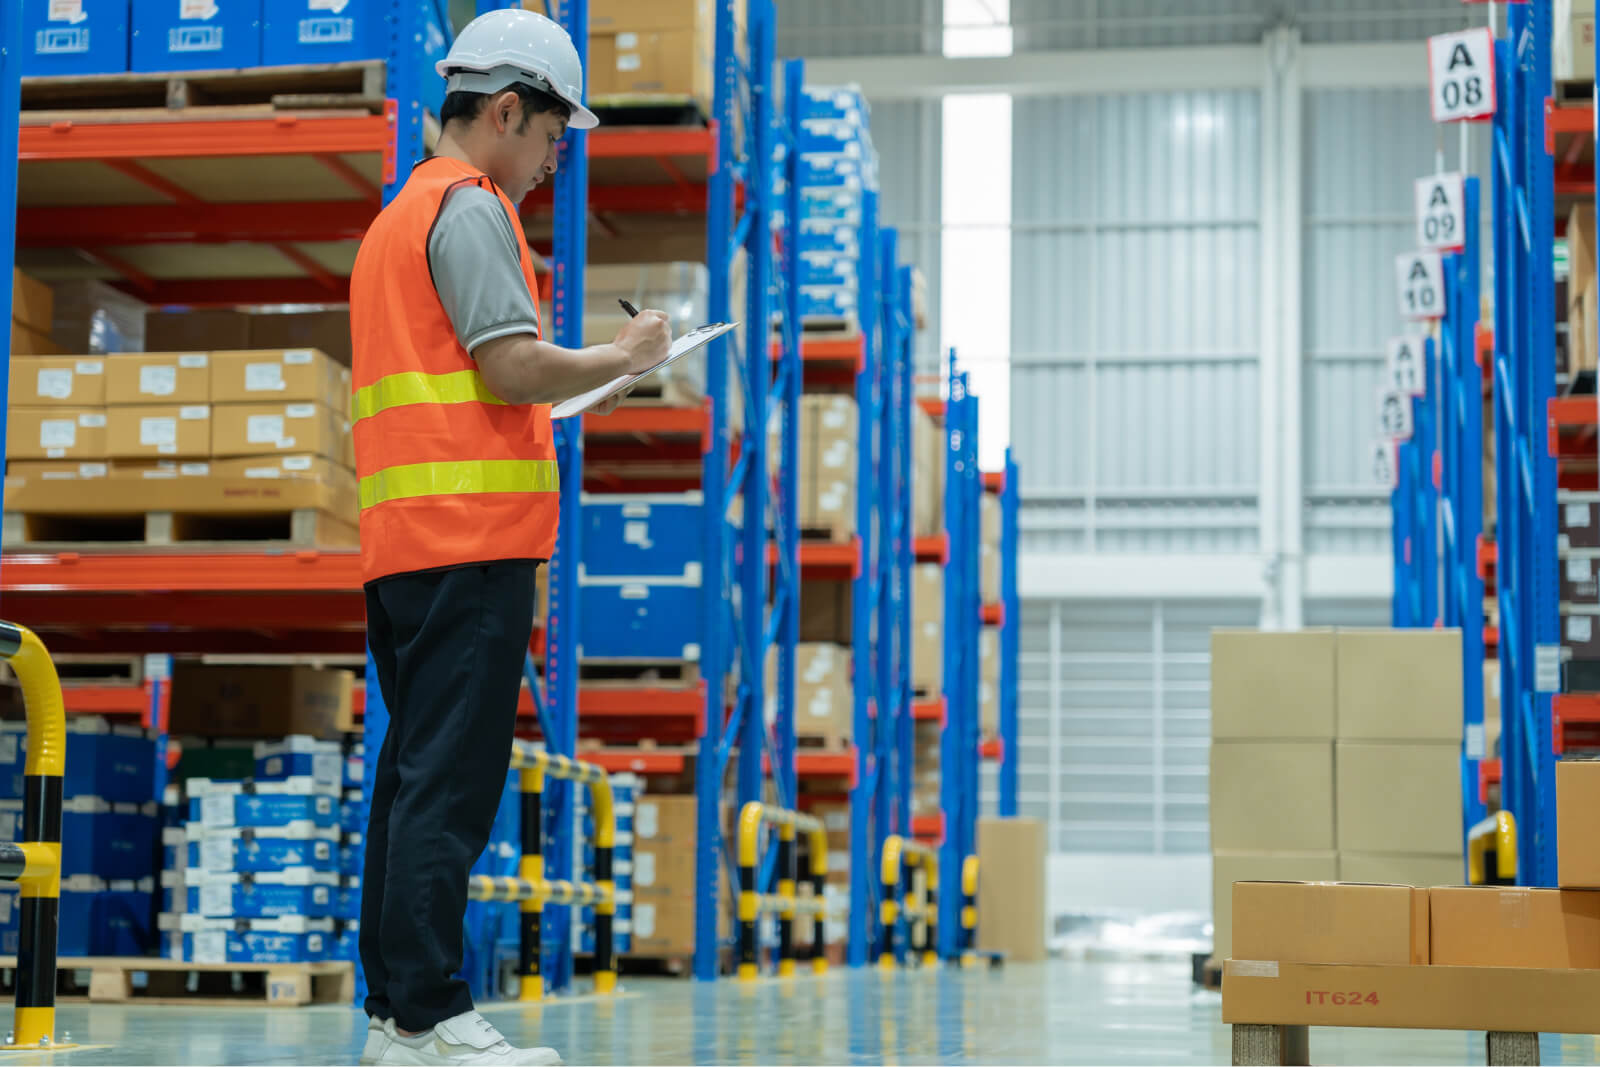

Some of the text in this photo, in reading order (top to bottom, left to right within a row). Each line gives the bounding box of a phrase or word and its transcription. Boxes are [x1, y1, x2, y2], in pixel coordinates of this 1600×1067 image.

[1448, 43, 1473, 70] A
[1443, 77, 1482, 109] 08
[1430, 184, 1448, 207] A
[1425, 213, 1455, 241] 09
[1409, 260, 1428, 280] A
[1405, 287, 1435, 309] 10
[1397, 343, 1413, 361] A
[1306, 990, 1379, 1006] IT624
